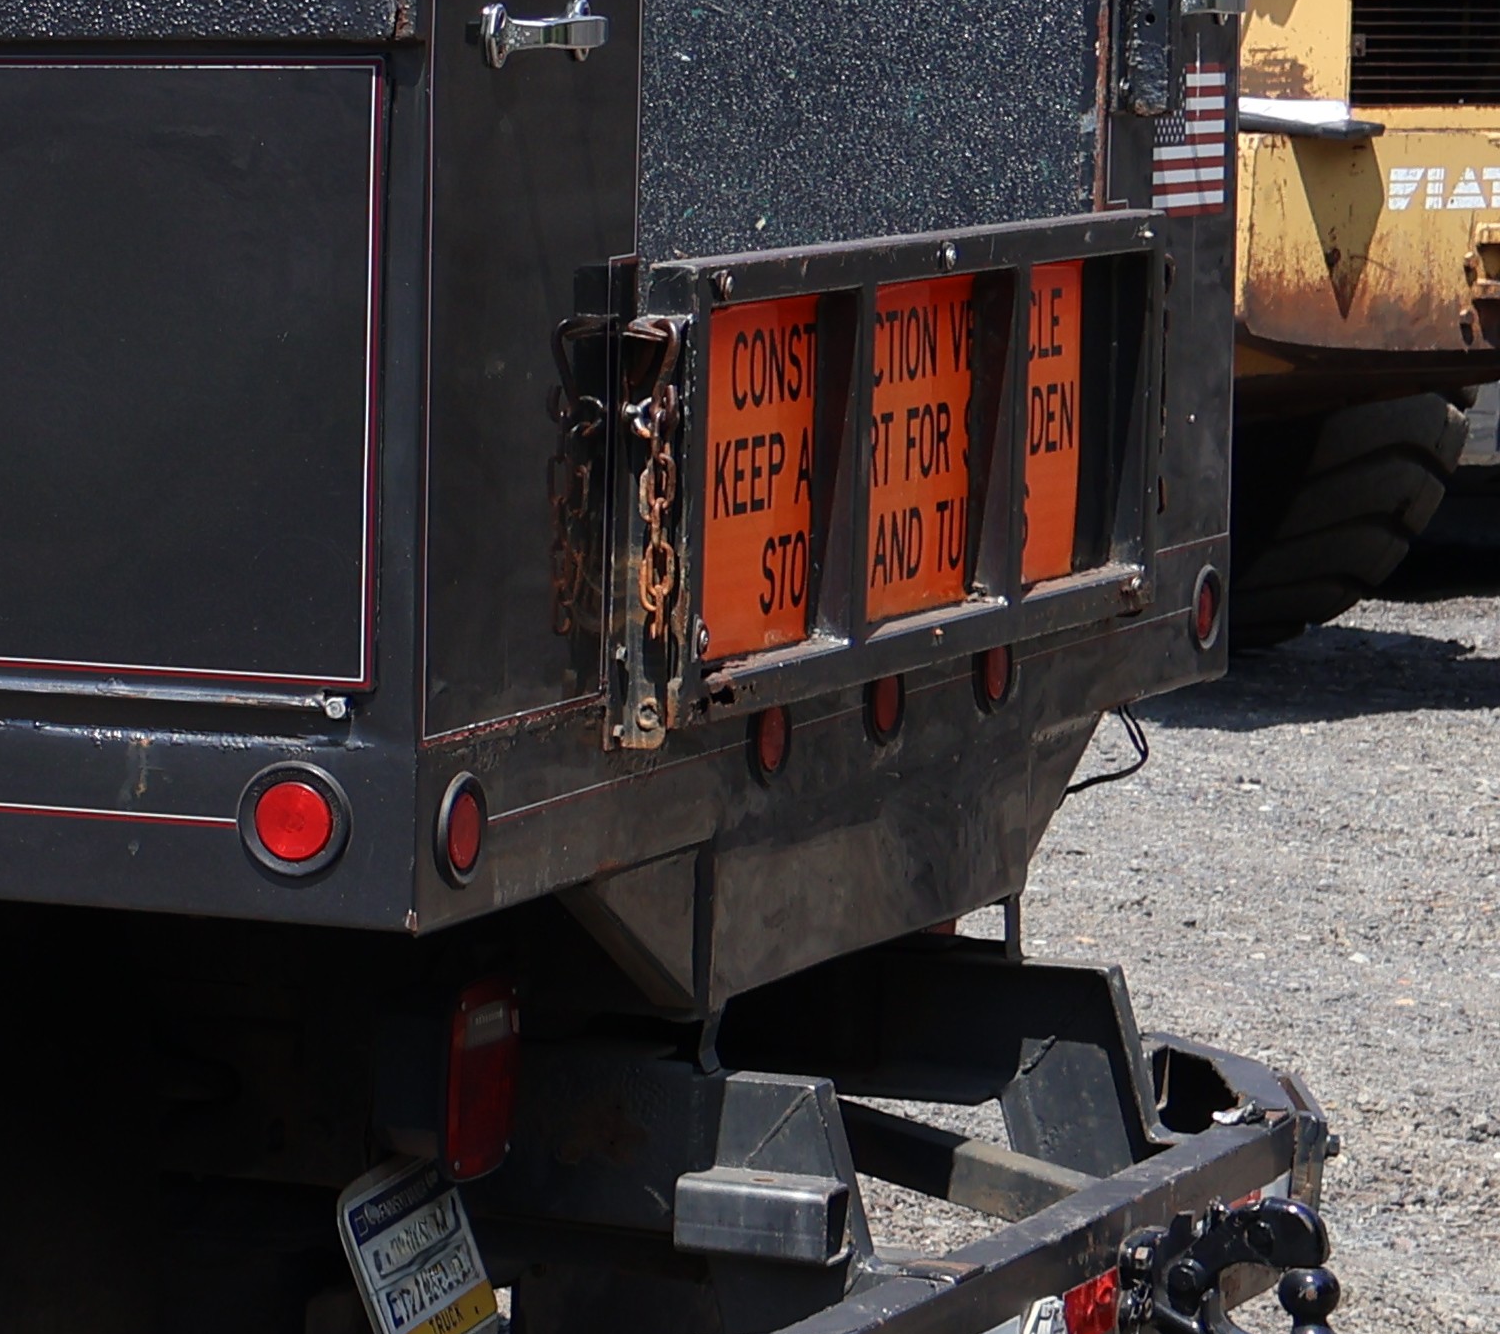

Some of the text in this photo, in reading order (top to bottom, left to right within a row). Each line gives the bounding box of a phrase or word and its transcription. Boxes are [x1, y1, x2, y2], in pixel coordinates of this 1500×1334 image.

[713, 432, 786, 520] KEEP
[905, 401, 951, 482] FOR
[759, 529, 808, 616] STO
[870, 505, 923, 589] AND
